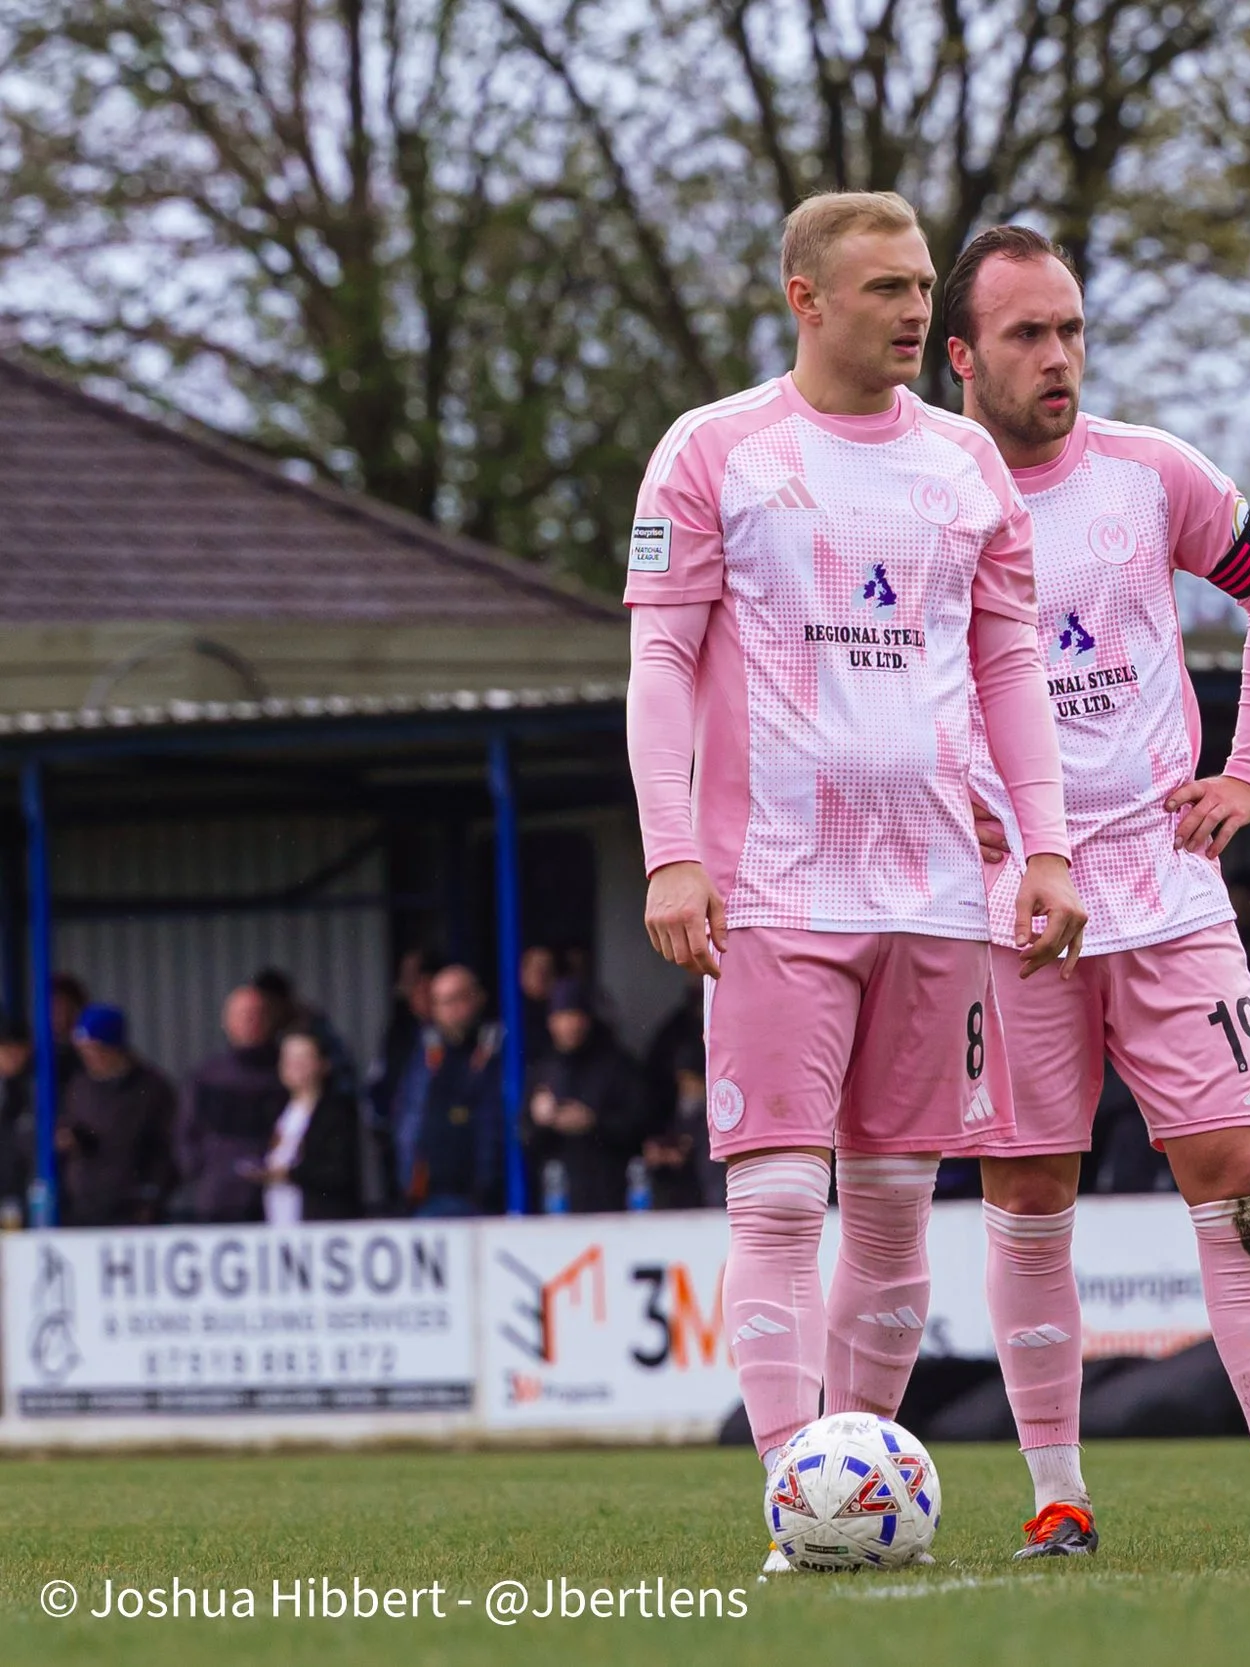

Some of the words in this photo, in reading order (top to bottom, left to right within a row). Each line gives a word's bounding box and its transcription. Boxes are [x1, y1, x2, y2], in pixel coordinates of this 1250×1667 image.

[804, 625, 880, 644] REGIONAL
[849, 650, 872, 667] UK
[876, 651, 908, 669] LTD.
[1047, 675, 1086, 697] ONAL
[1087, 665, 1138, 689] STEELS
[1056, 699, 1081, 718] UK
[1082, 694, 1115, 714] LTD.
[966, 1000, 984, 1081] 8
[100, 1236, 448, 1298] HIGGINSON
[326, 1303, 451, 1331] SERVICES
